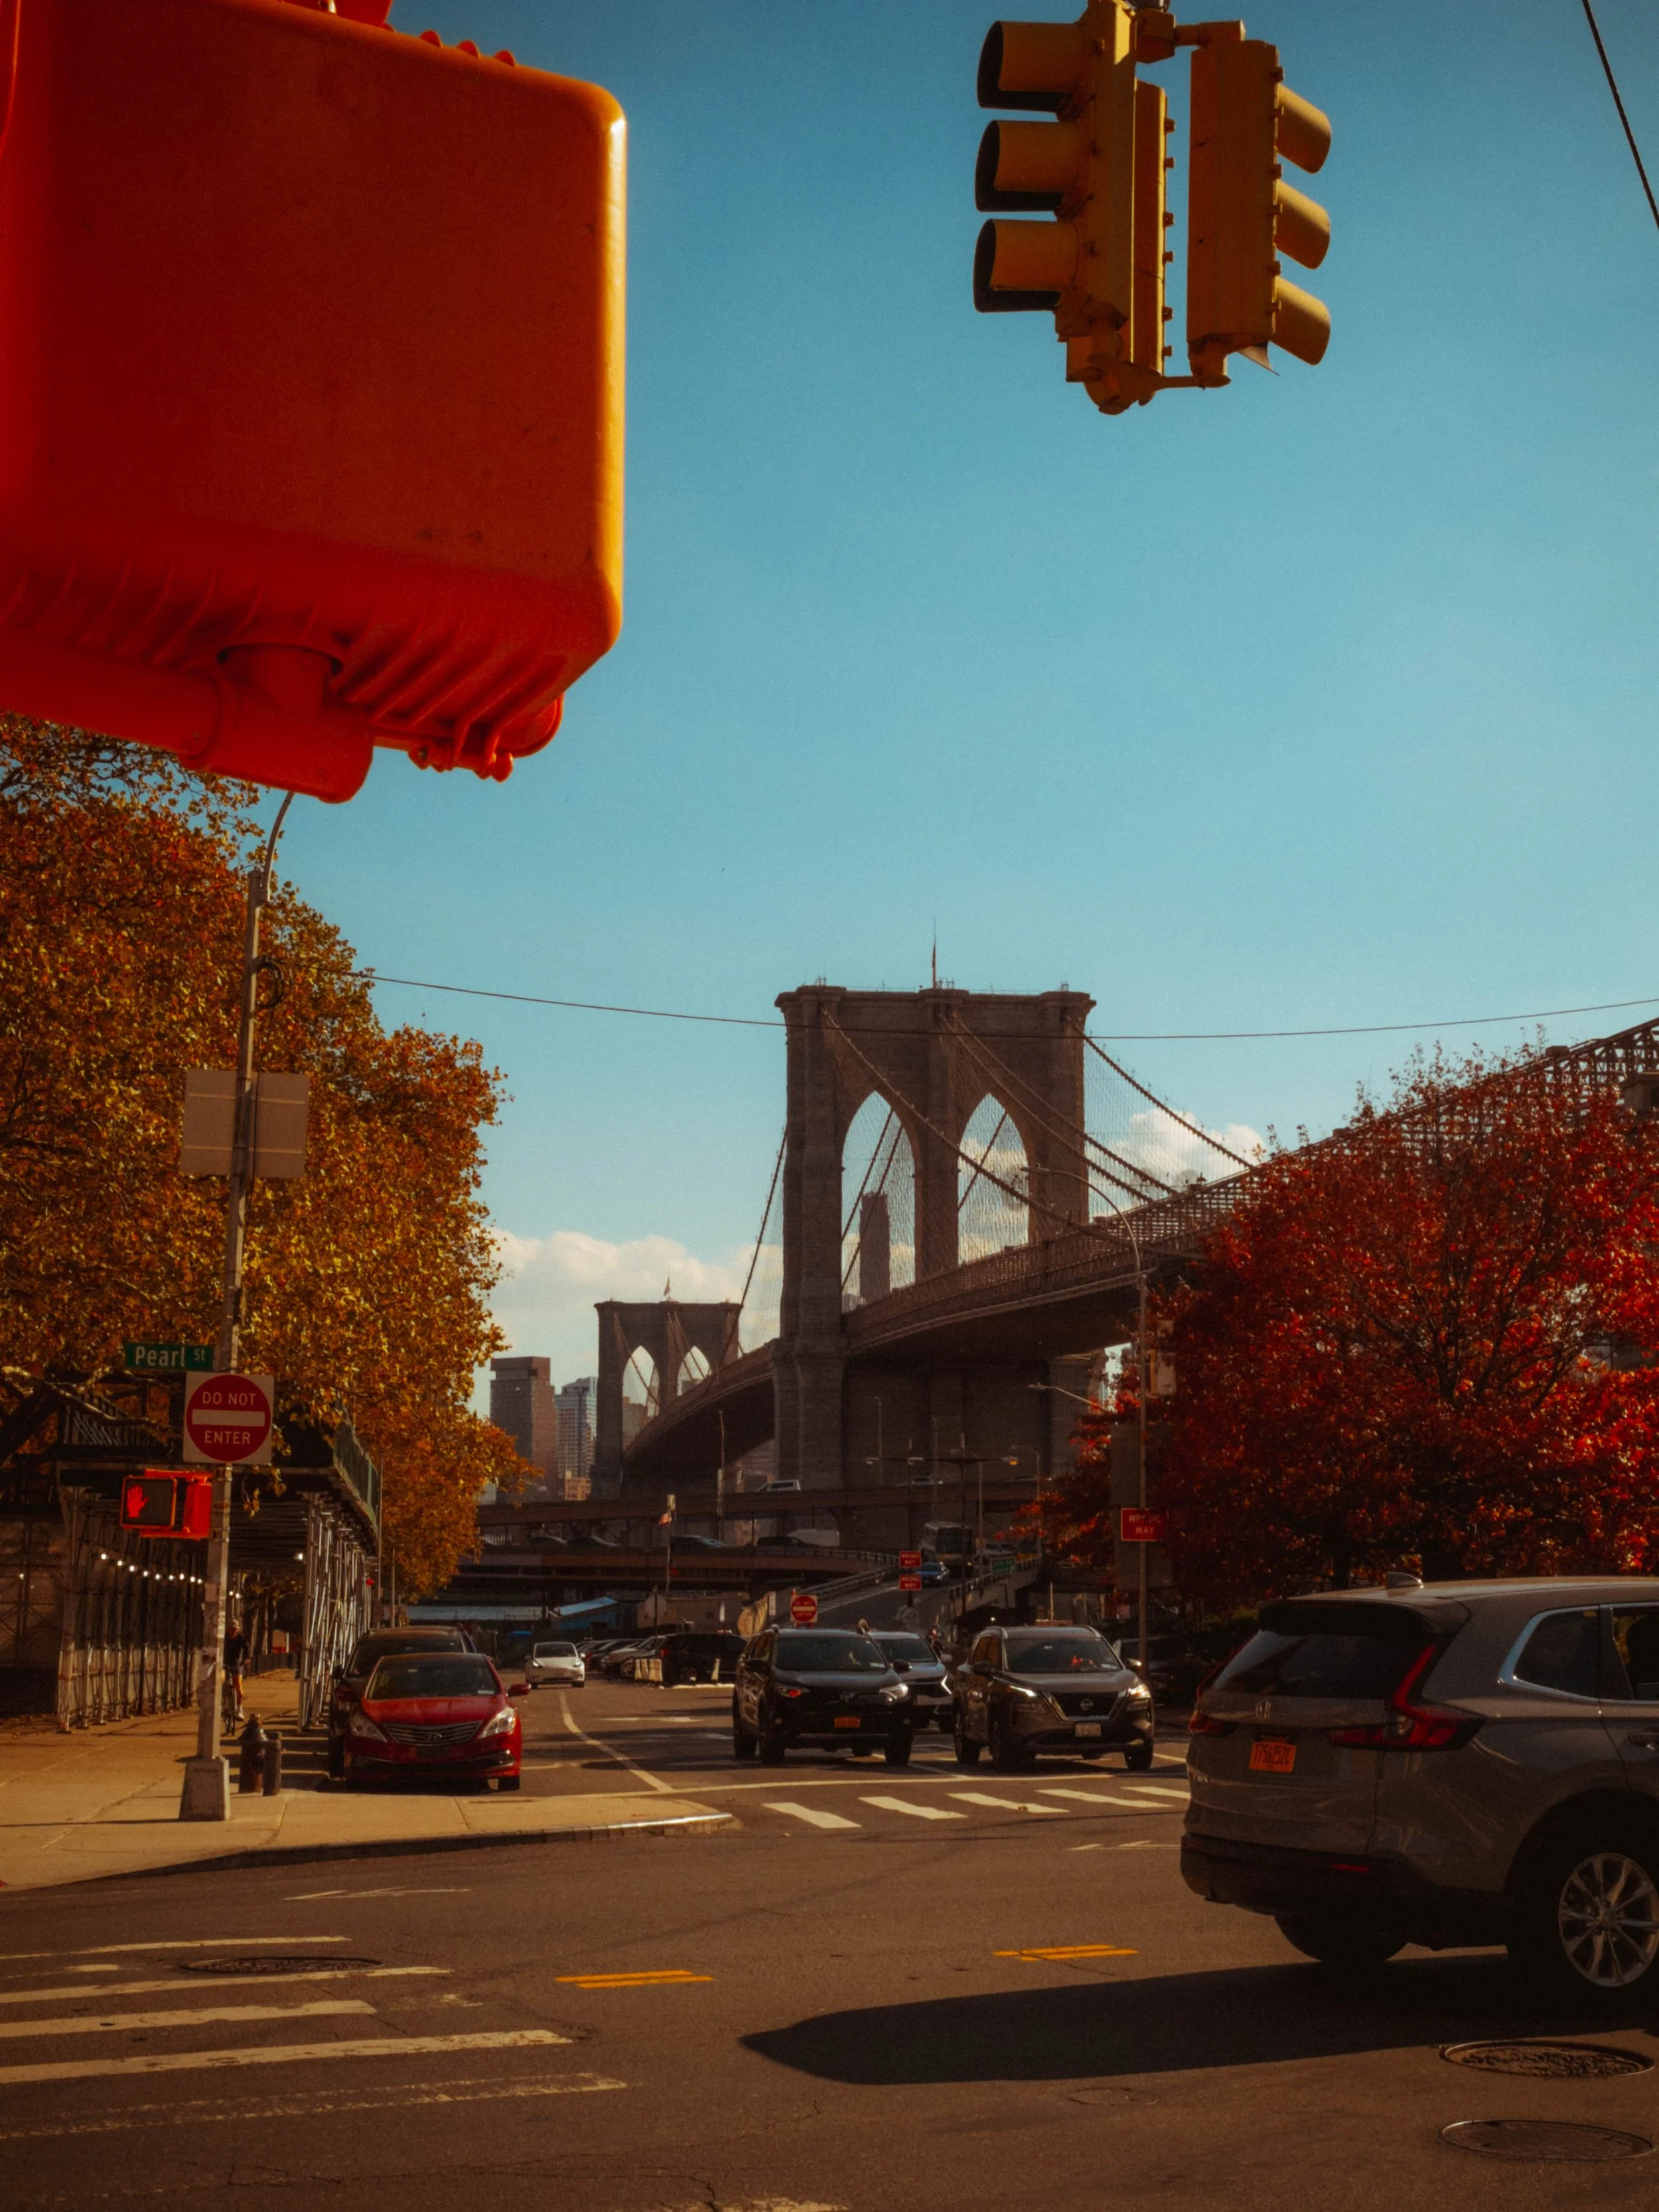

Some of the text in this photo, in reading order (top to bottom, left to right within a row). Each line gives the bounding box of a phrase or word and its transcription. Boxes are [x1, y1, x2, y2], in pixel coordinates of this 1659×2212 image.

[135, 1346, 186, 1367] Pearl
[202, 1391, 257, 1406] DO NOT
[204, 1430, 252, 1445] ENTER
[1135, 1526, 1155, 1535] WAY
